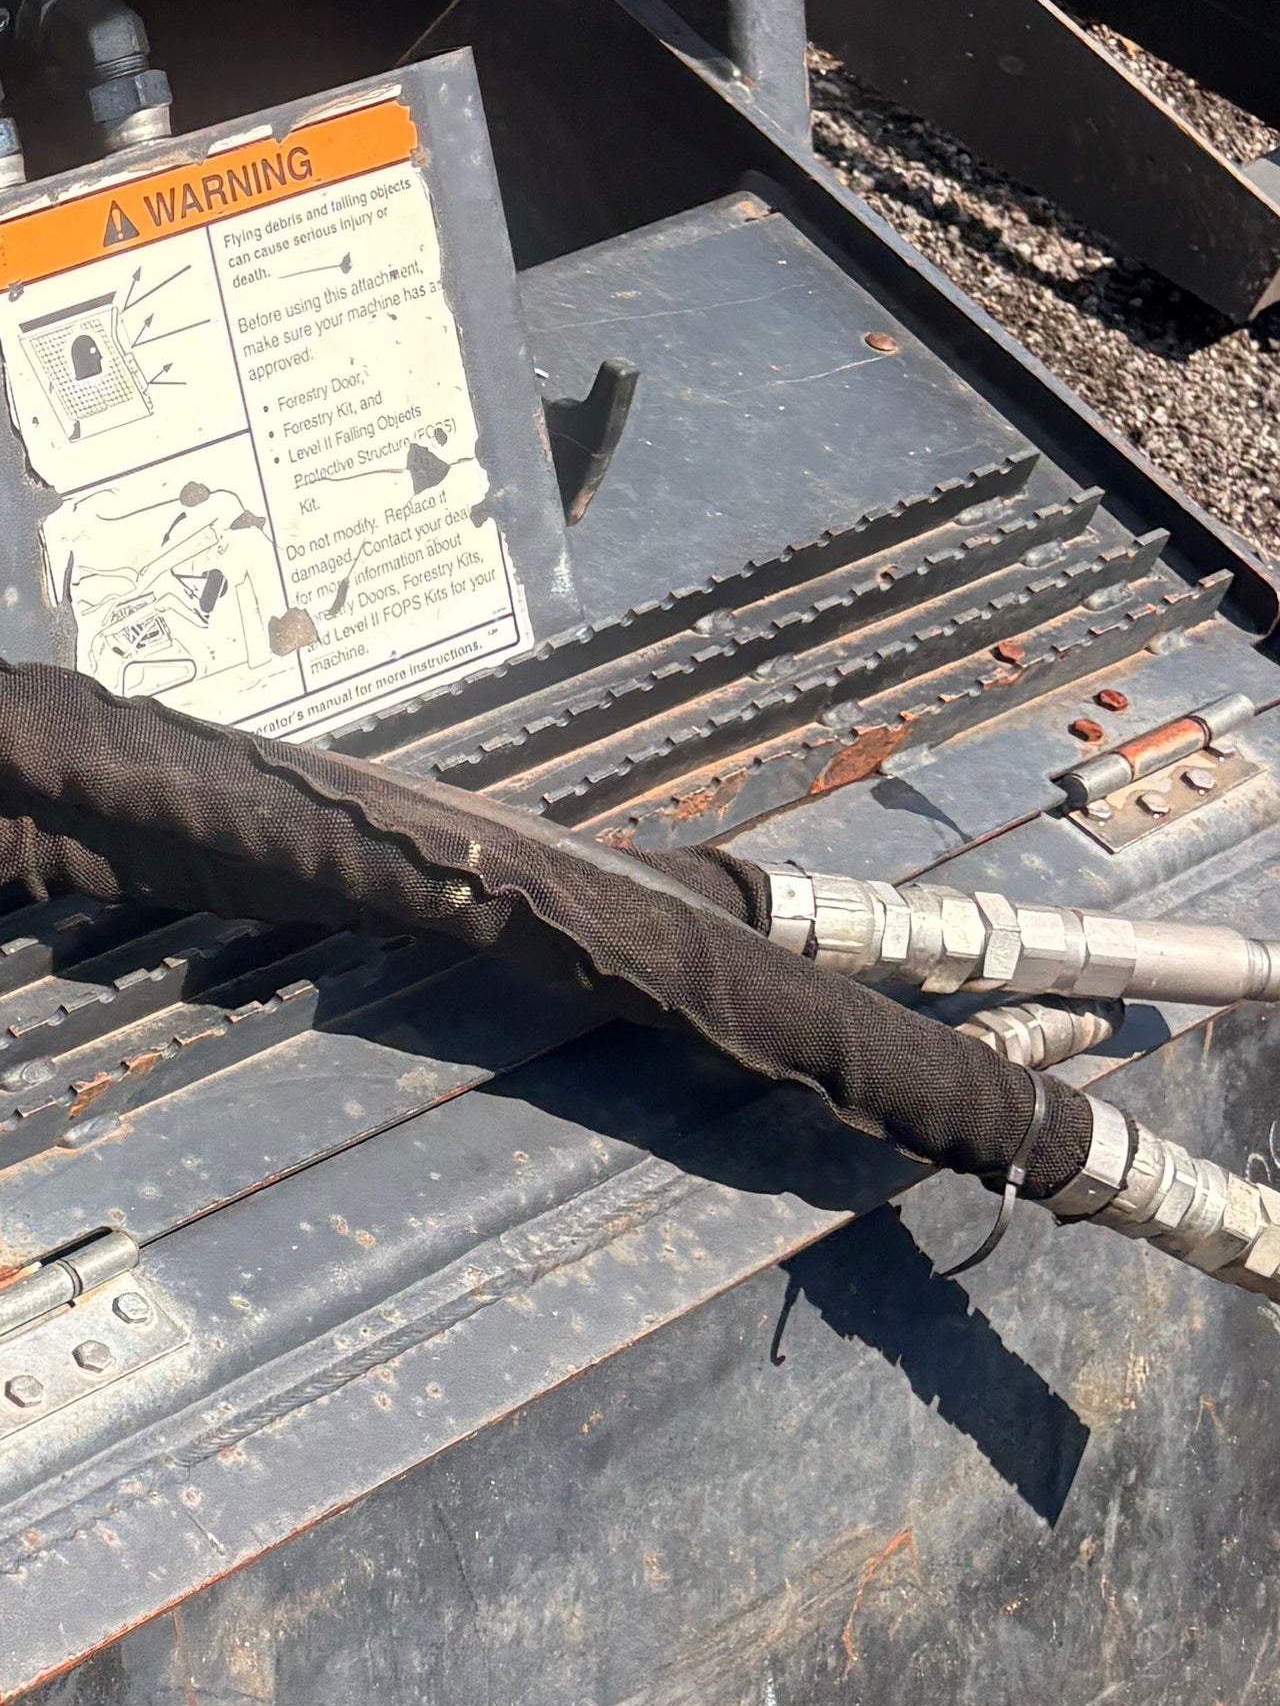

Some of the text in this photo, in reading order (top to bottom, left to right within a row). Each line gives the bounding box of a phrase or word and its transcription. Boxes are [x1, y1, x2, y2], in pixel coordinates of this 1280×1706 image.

[144, 146, 312, 226] WARNING
[223, 178, 411, 248] Flying debris and falling objects
[227, 206, 388, 268] can cause serious injury or
[232, 267, 271, 288] death.
[237, 260, 424, 334] Before using this attachment,
[242, 334, 280, 357] make
[283, 324, 312, 344] sure
[314, 312, 343, 337] your
[346, 293, 401, 321] machine
[402, 284, 427, 301] has
[277, 372, 365, 411] Forestry Door,
[282, 389, 383, 437] Forestry Kit, and
[287, 439, 322, 464] Level
[334, 422, 375, 445] Falling
[376, 405, 422, 430] Objects
[293, 457, 354, 489] Protective
[356, 436, 412, 465] Structure
[285, 543, 306, 561] Do
[308, 532, 331, 552] not
[332, 517, 378, 543] modify.
[383, 496, 436, 524] Replace
[298, 497, 320, 515] Kit.
[361, 527, 412, 557] Contact
[414, 517, 441, 541] your
[443, 501, 474, 527] deal
[295, 532, 462, 605] for mor information about
[357, 551, 484, 608] Doors, Forestry Kits,
[333, 615, 368, 642] Level
[370, 611, 380, 627] II
[382, 594, 422, 622] FOPS
[423, 587, 448, 606] Kits
[449, 579, 466, 596] for
[468, 568, 495, 592] your
[252, 639, 483, 737] erator's manual for more instructions.
[310, 643, 369, 674] machine.
